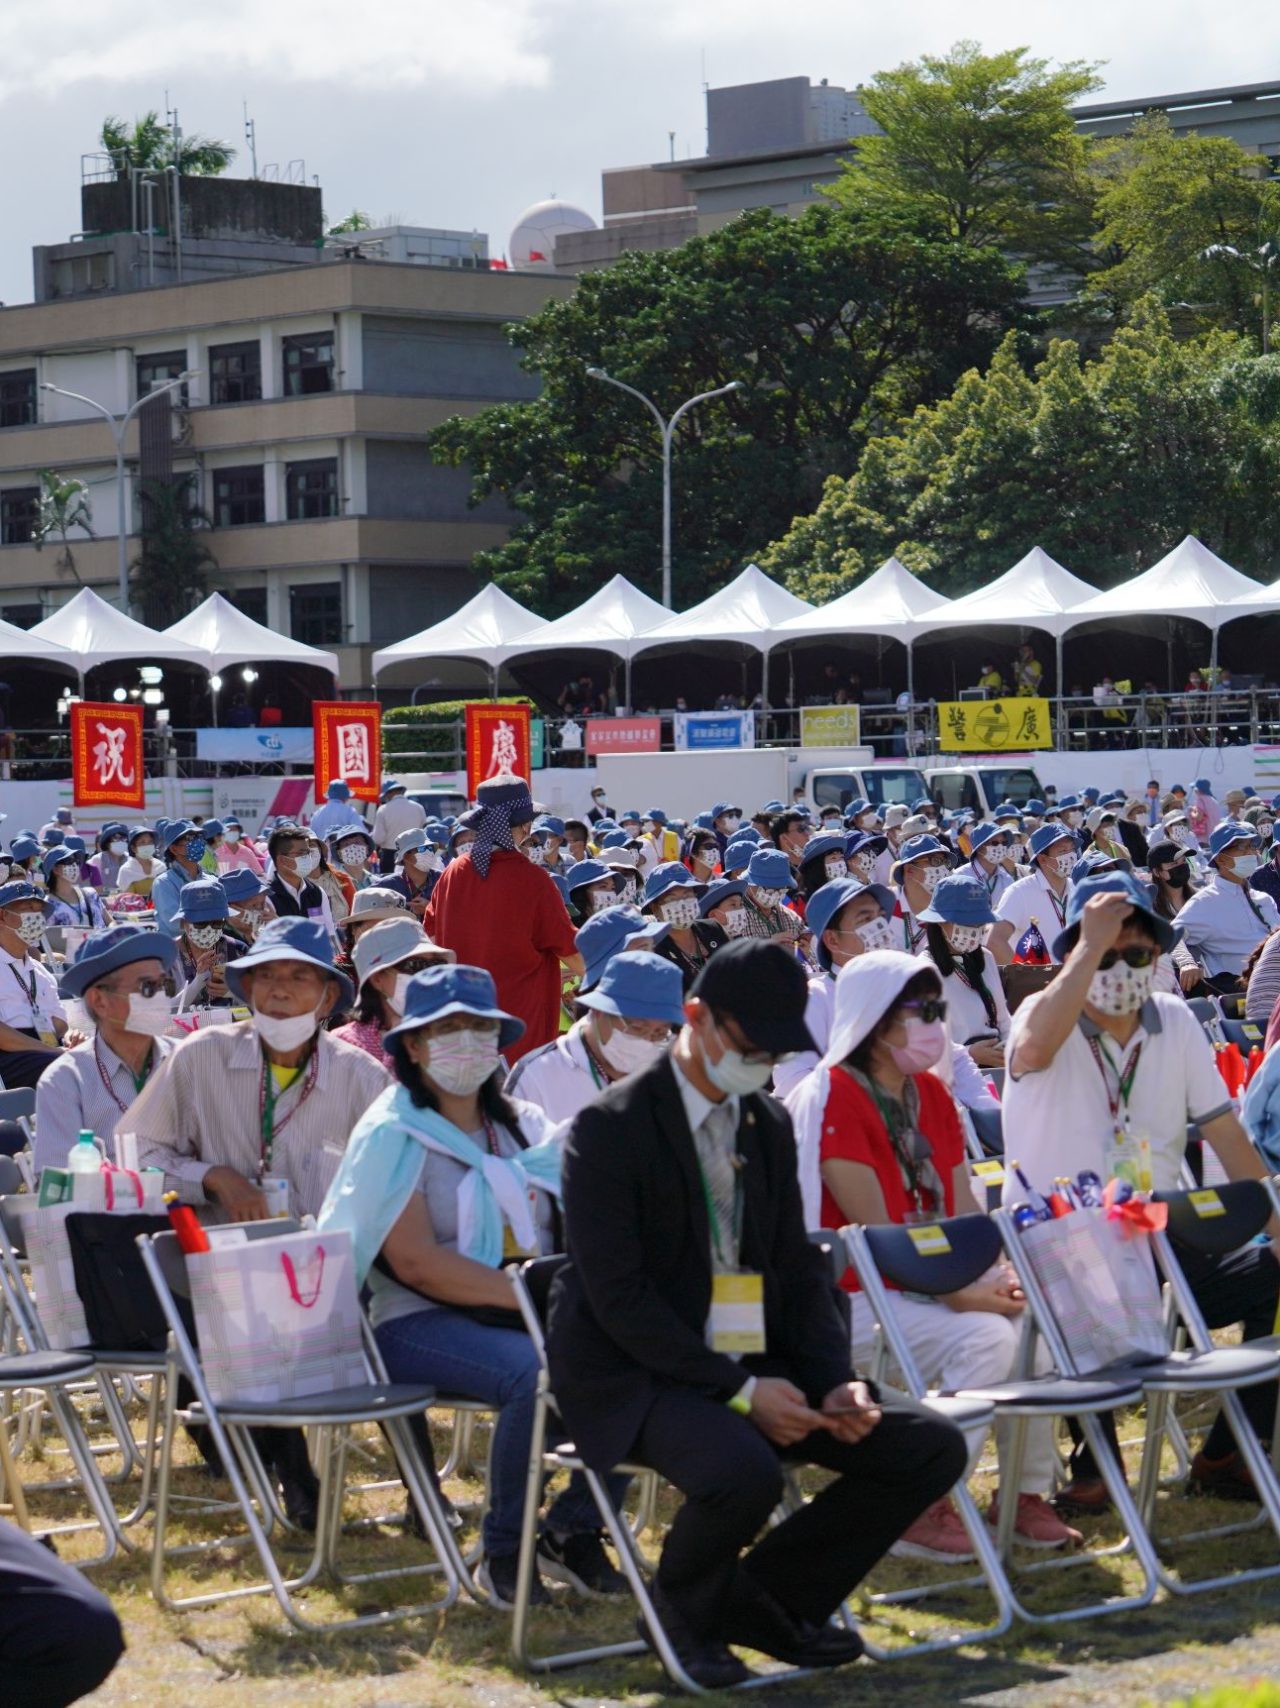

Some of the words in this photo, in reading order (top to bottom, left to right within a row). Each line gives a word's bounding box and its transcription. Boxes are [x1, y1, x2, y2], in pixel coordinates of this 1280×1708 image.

[92, 722, 136, 788] 祝
[335, 722, 370, 785] 國
[1016, 706, 1040, 741] 廣
